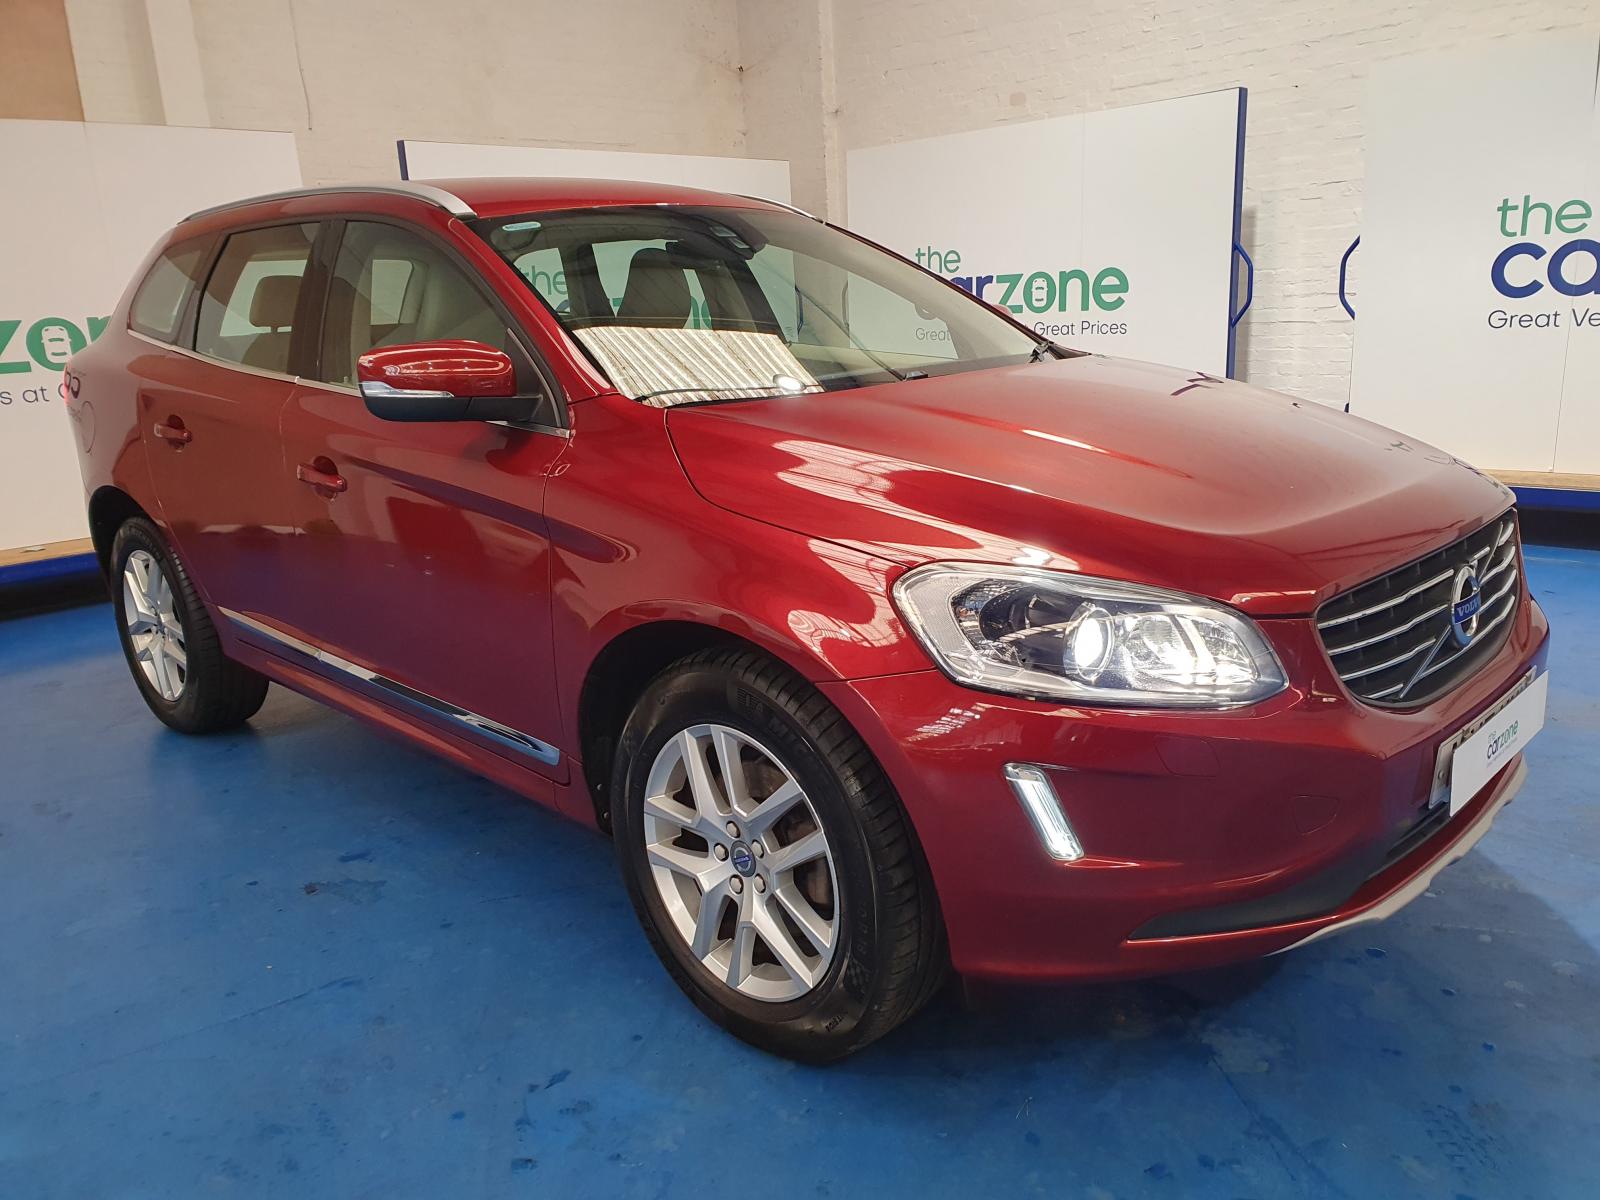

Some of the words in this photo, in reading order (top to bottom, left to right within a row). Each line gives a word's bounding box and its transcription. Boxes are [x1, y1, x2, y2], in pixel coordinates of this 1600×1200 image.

[1497, 195, 1593, 237] the
[915, 246, 961, 273] the
[1034, 321, 1075, 336] Great
[1081, 320, 1128, 335] Prices
[1488, 309, 1561, 329] Great
[22, 386, 50, 403] at
[1456, 598, 1480, 617] VOLV
[1487, 720, 1519, 759] carzone
